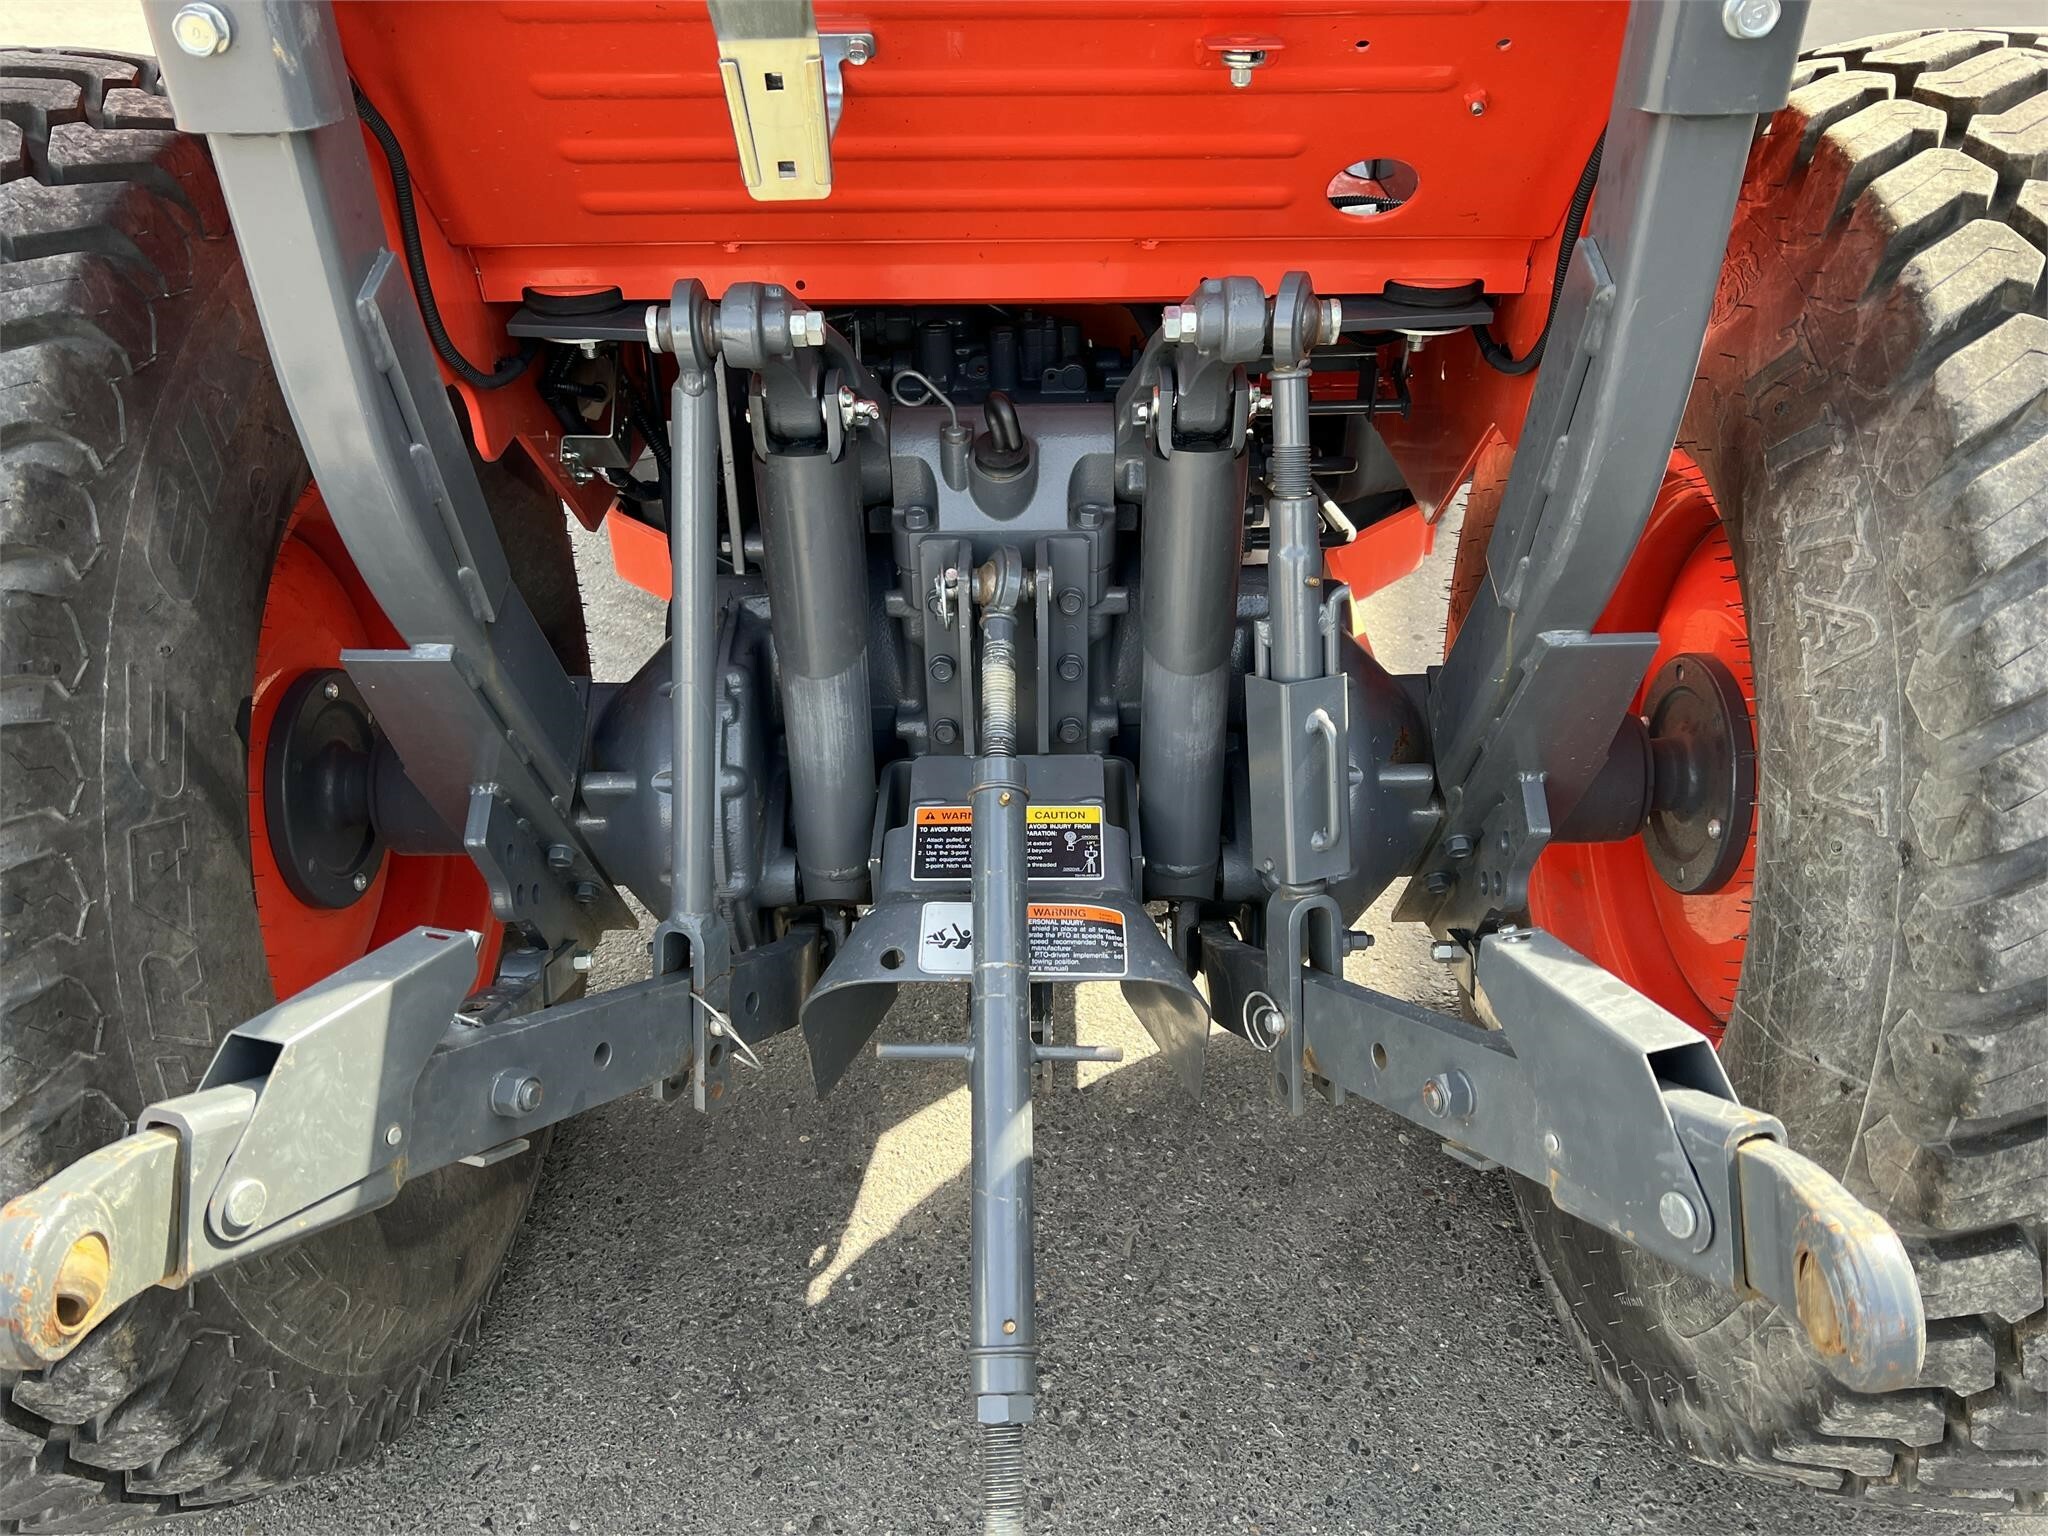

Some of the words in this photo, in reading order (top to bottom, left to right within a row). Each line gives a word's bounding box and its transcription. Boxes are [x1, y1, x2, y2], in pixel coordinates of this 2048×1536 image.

[1744, 311, 1889, 838] TITAN
[1034, 811, 1086, 820] CAUTION
[1033, 908, 1086, 918] WARNING
